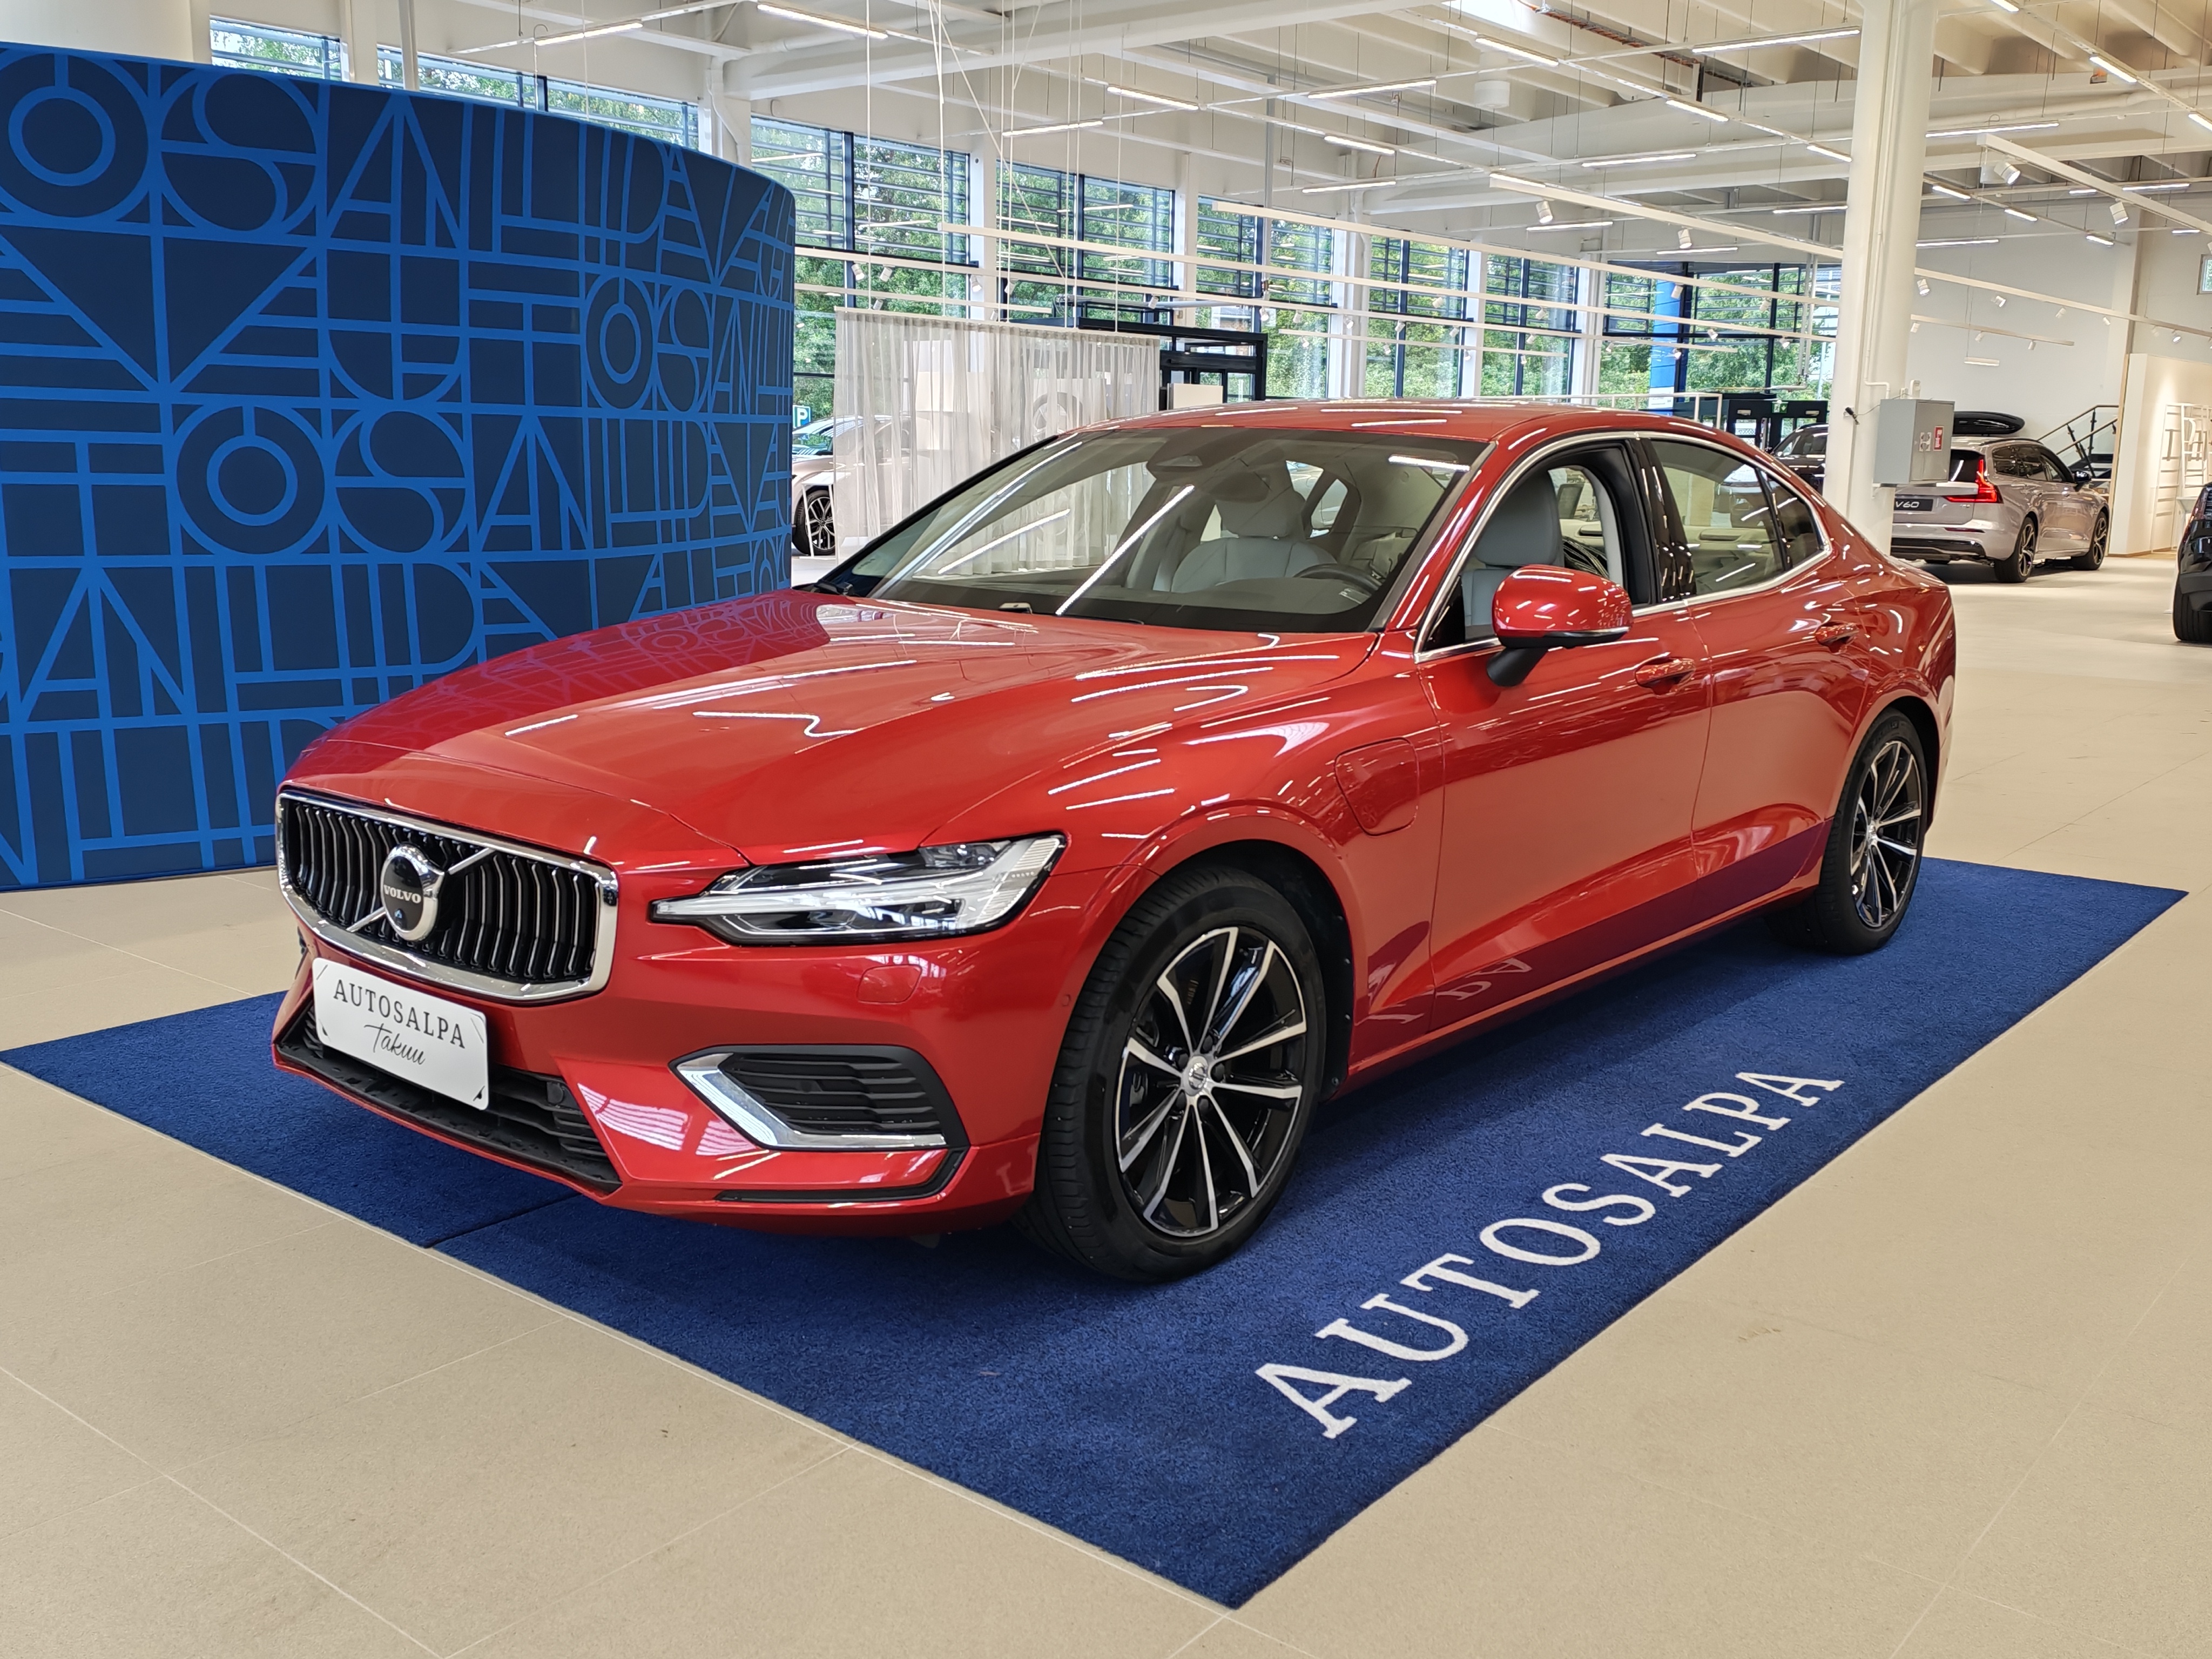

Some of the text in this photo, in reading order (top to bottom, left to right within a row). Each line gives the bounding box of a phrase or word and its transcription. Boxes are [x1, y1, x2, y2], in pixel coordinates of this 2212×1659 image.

[797, 407, 808, 427] P
[383, 884, 422, 904] VOLVO
[333, 979, 466, 1049] AUTOSALPA
[363, 1022, 426, 1065] Takuu
[1254, 1071, 1846, 1439] AUTOSALPA
